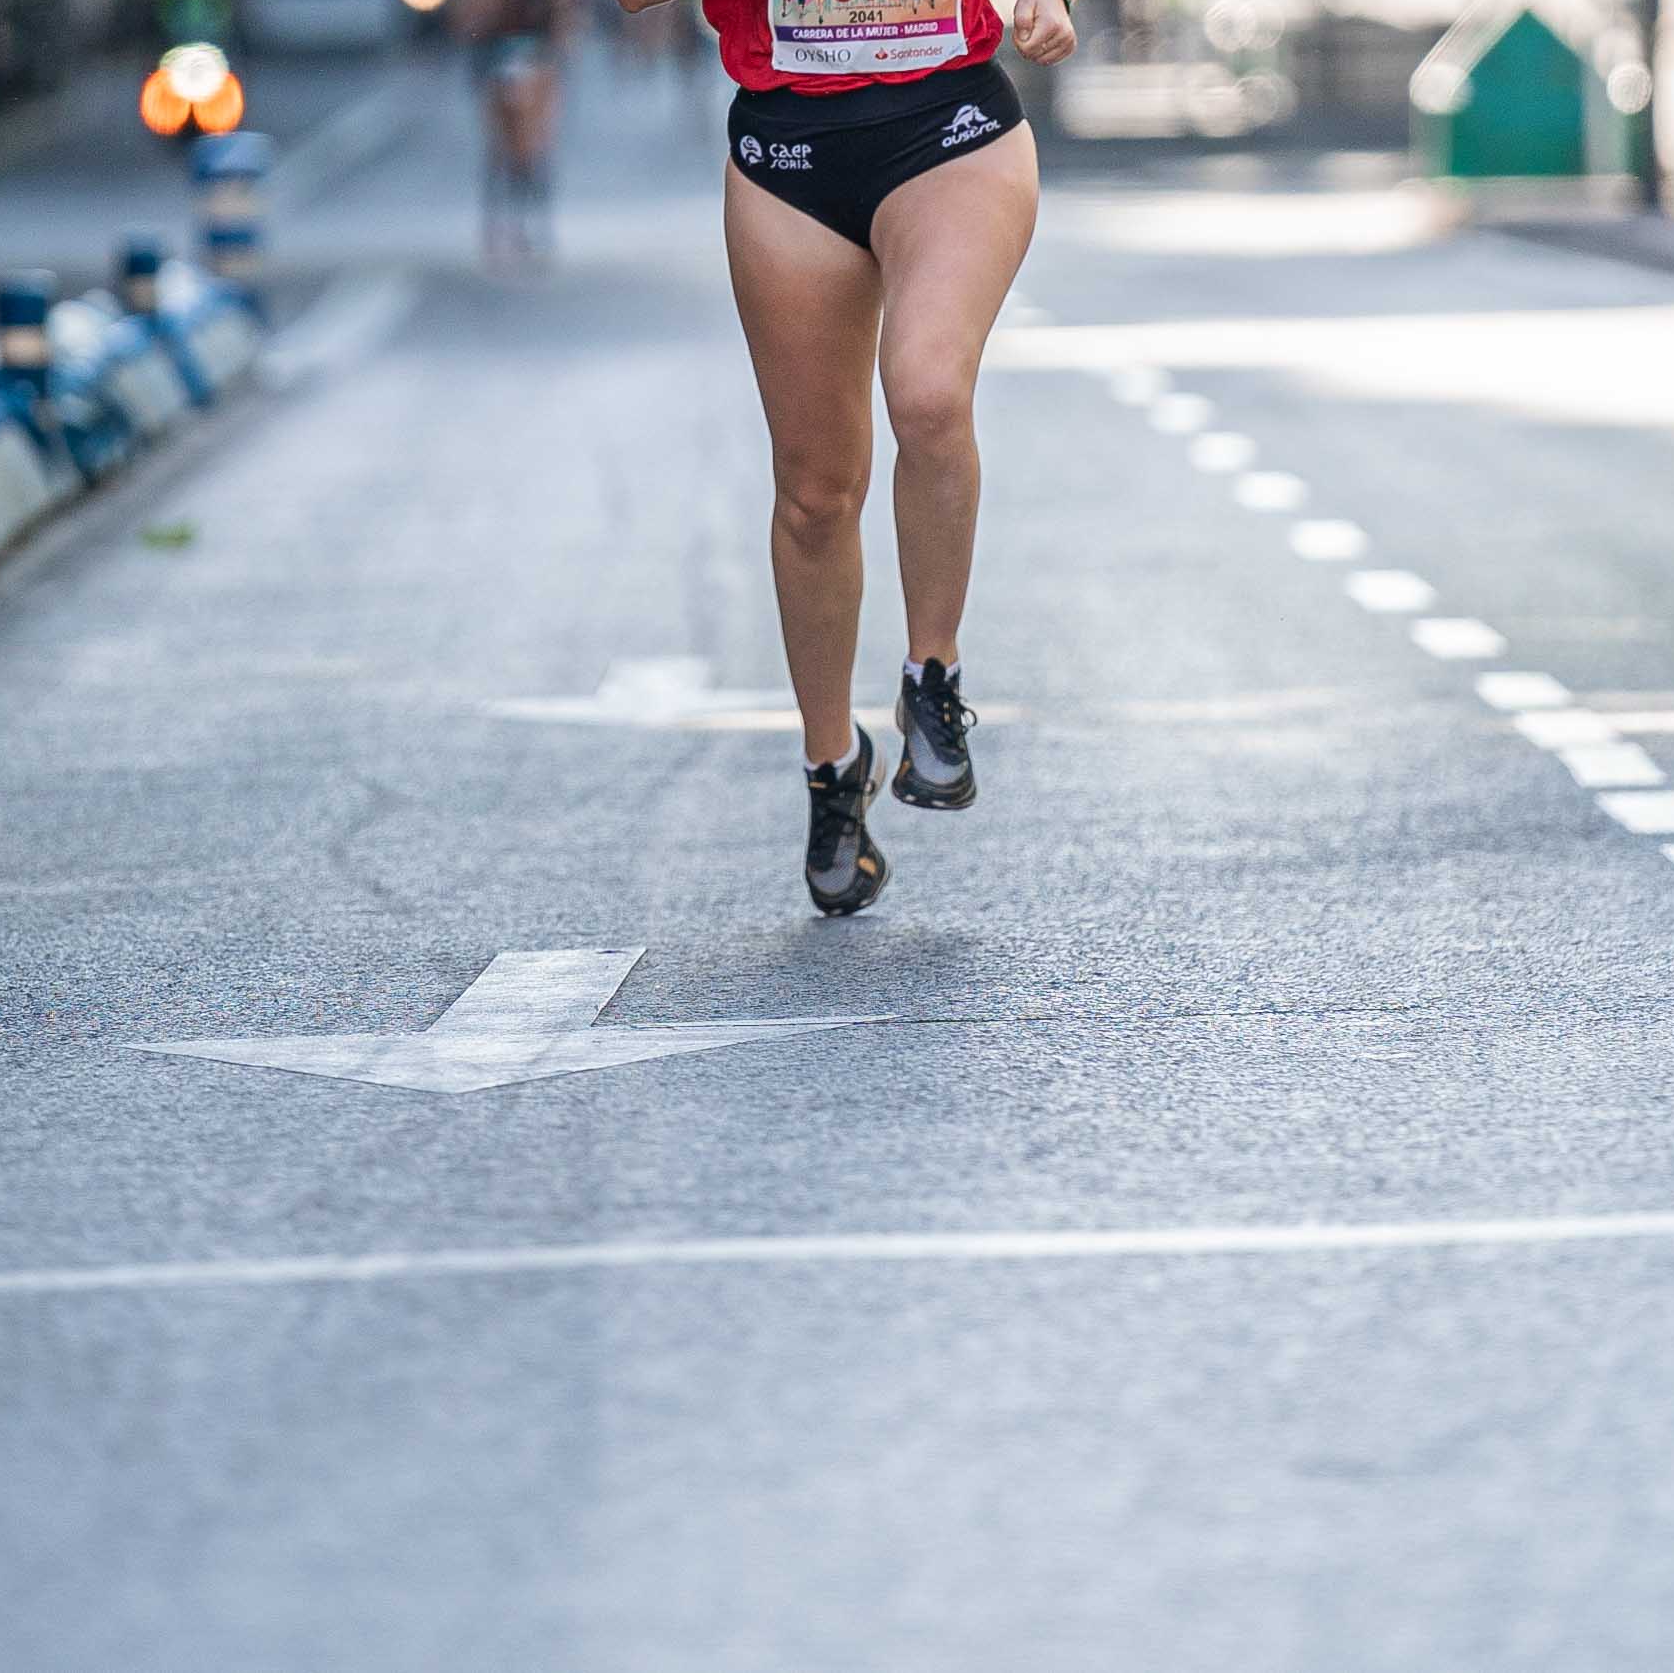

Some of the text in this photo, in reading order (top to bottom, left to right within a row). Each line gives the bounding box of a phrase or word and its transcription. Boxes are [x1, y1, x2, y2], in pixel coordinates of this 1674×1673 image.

[849, 10, 883, 24] 2041
[792, 22, 938, 39] CARRERA DE LA MUJER MADRID
[795, 48, 851, 62] OYSHO
[890, 47, 943, 60] Santander
